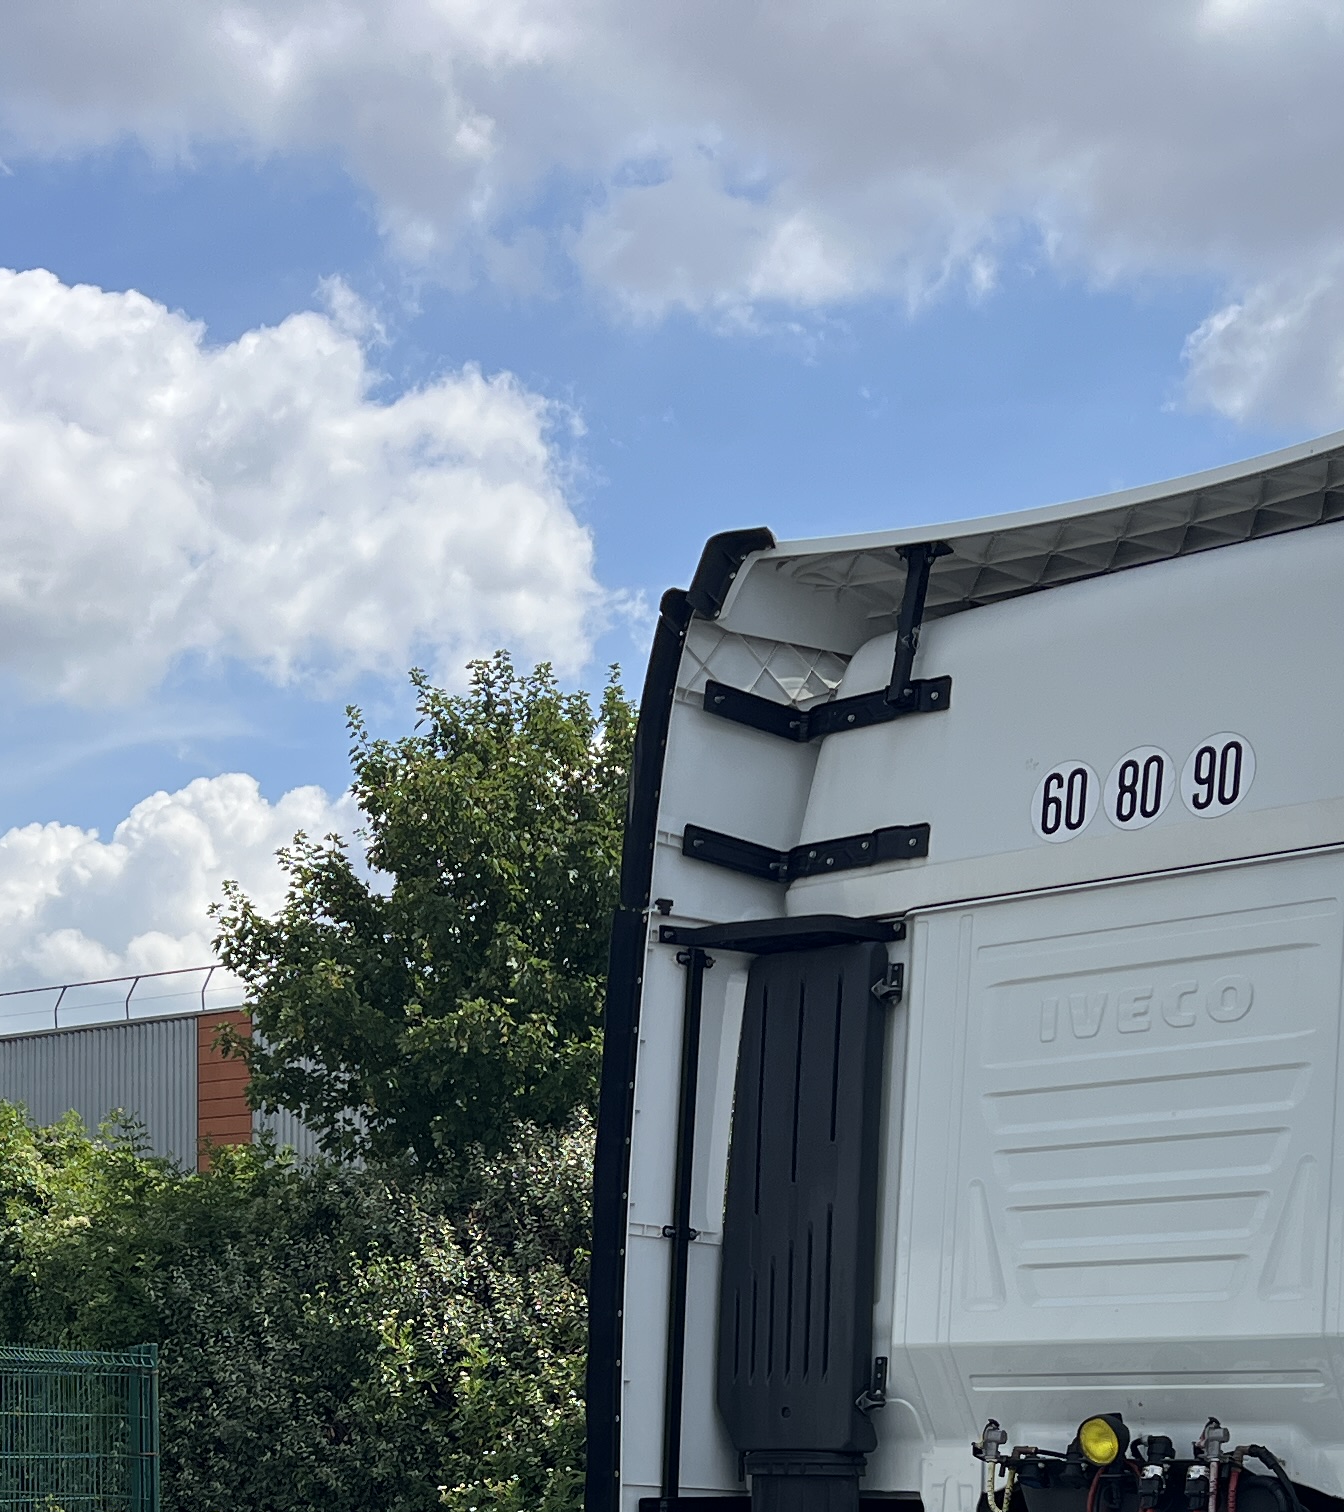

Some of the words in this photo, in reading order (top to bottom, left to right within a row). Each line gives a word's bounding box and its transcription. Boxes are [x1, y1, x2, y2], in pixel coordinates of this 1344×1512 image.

[1041, 767, 1088, 835] 60
[1116, 754, 1164, 822] 80
[1192, 740, 1243, 810] 90
[1039, 974, 1254, 1043] IVECO
